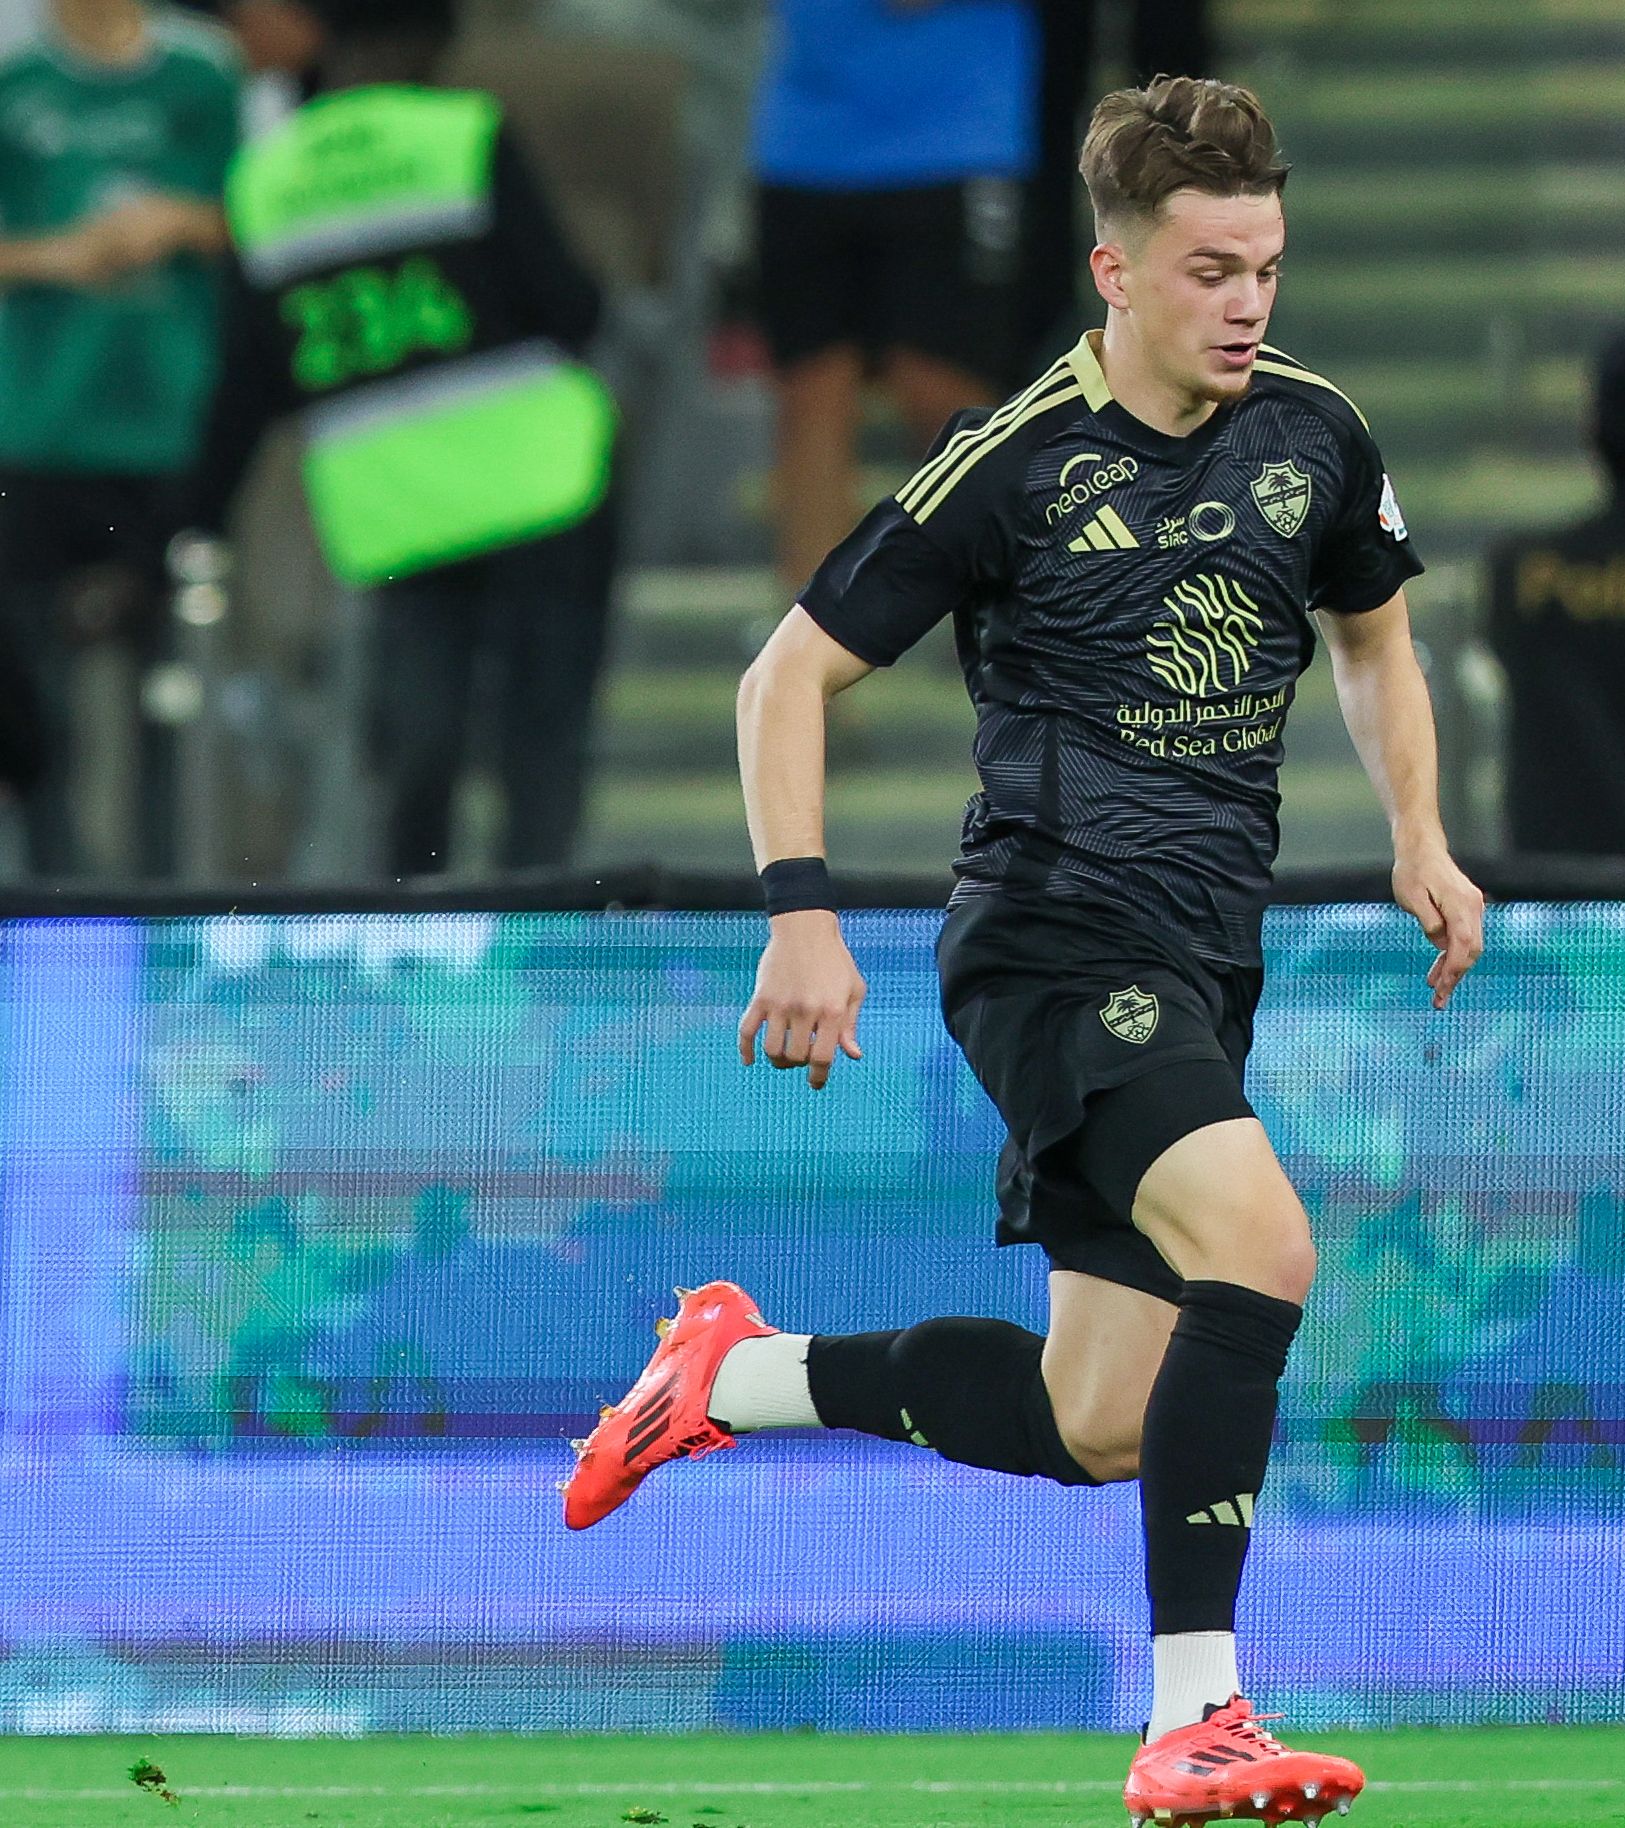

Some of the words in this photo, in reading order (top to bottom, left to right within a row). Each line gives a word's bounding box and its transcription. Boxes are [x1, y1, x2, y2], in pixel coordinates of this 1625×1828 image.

[1045, 456, 1138, 525] neoleap
[1157, 530, 1188, 549] SIRC
[1116, 698, 1191, 731] الدولية
[1172, 735, 1215, 757] Sea
[1222, 717, 1281, 752] Global
